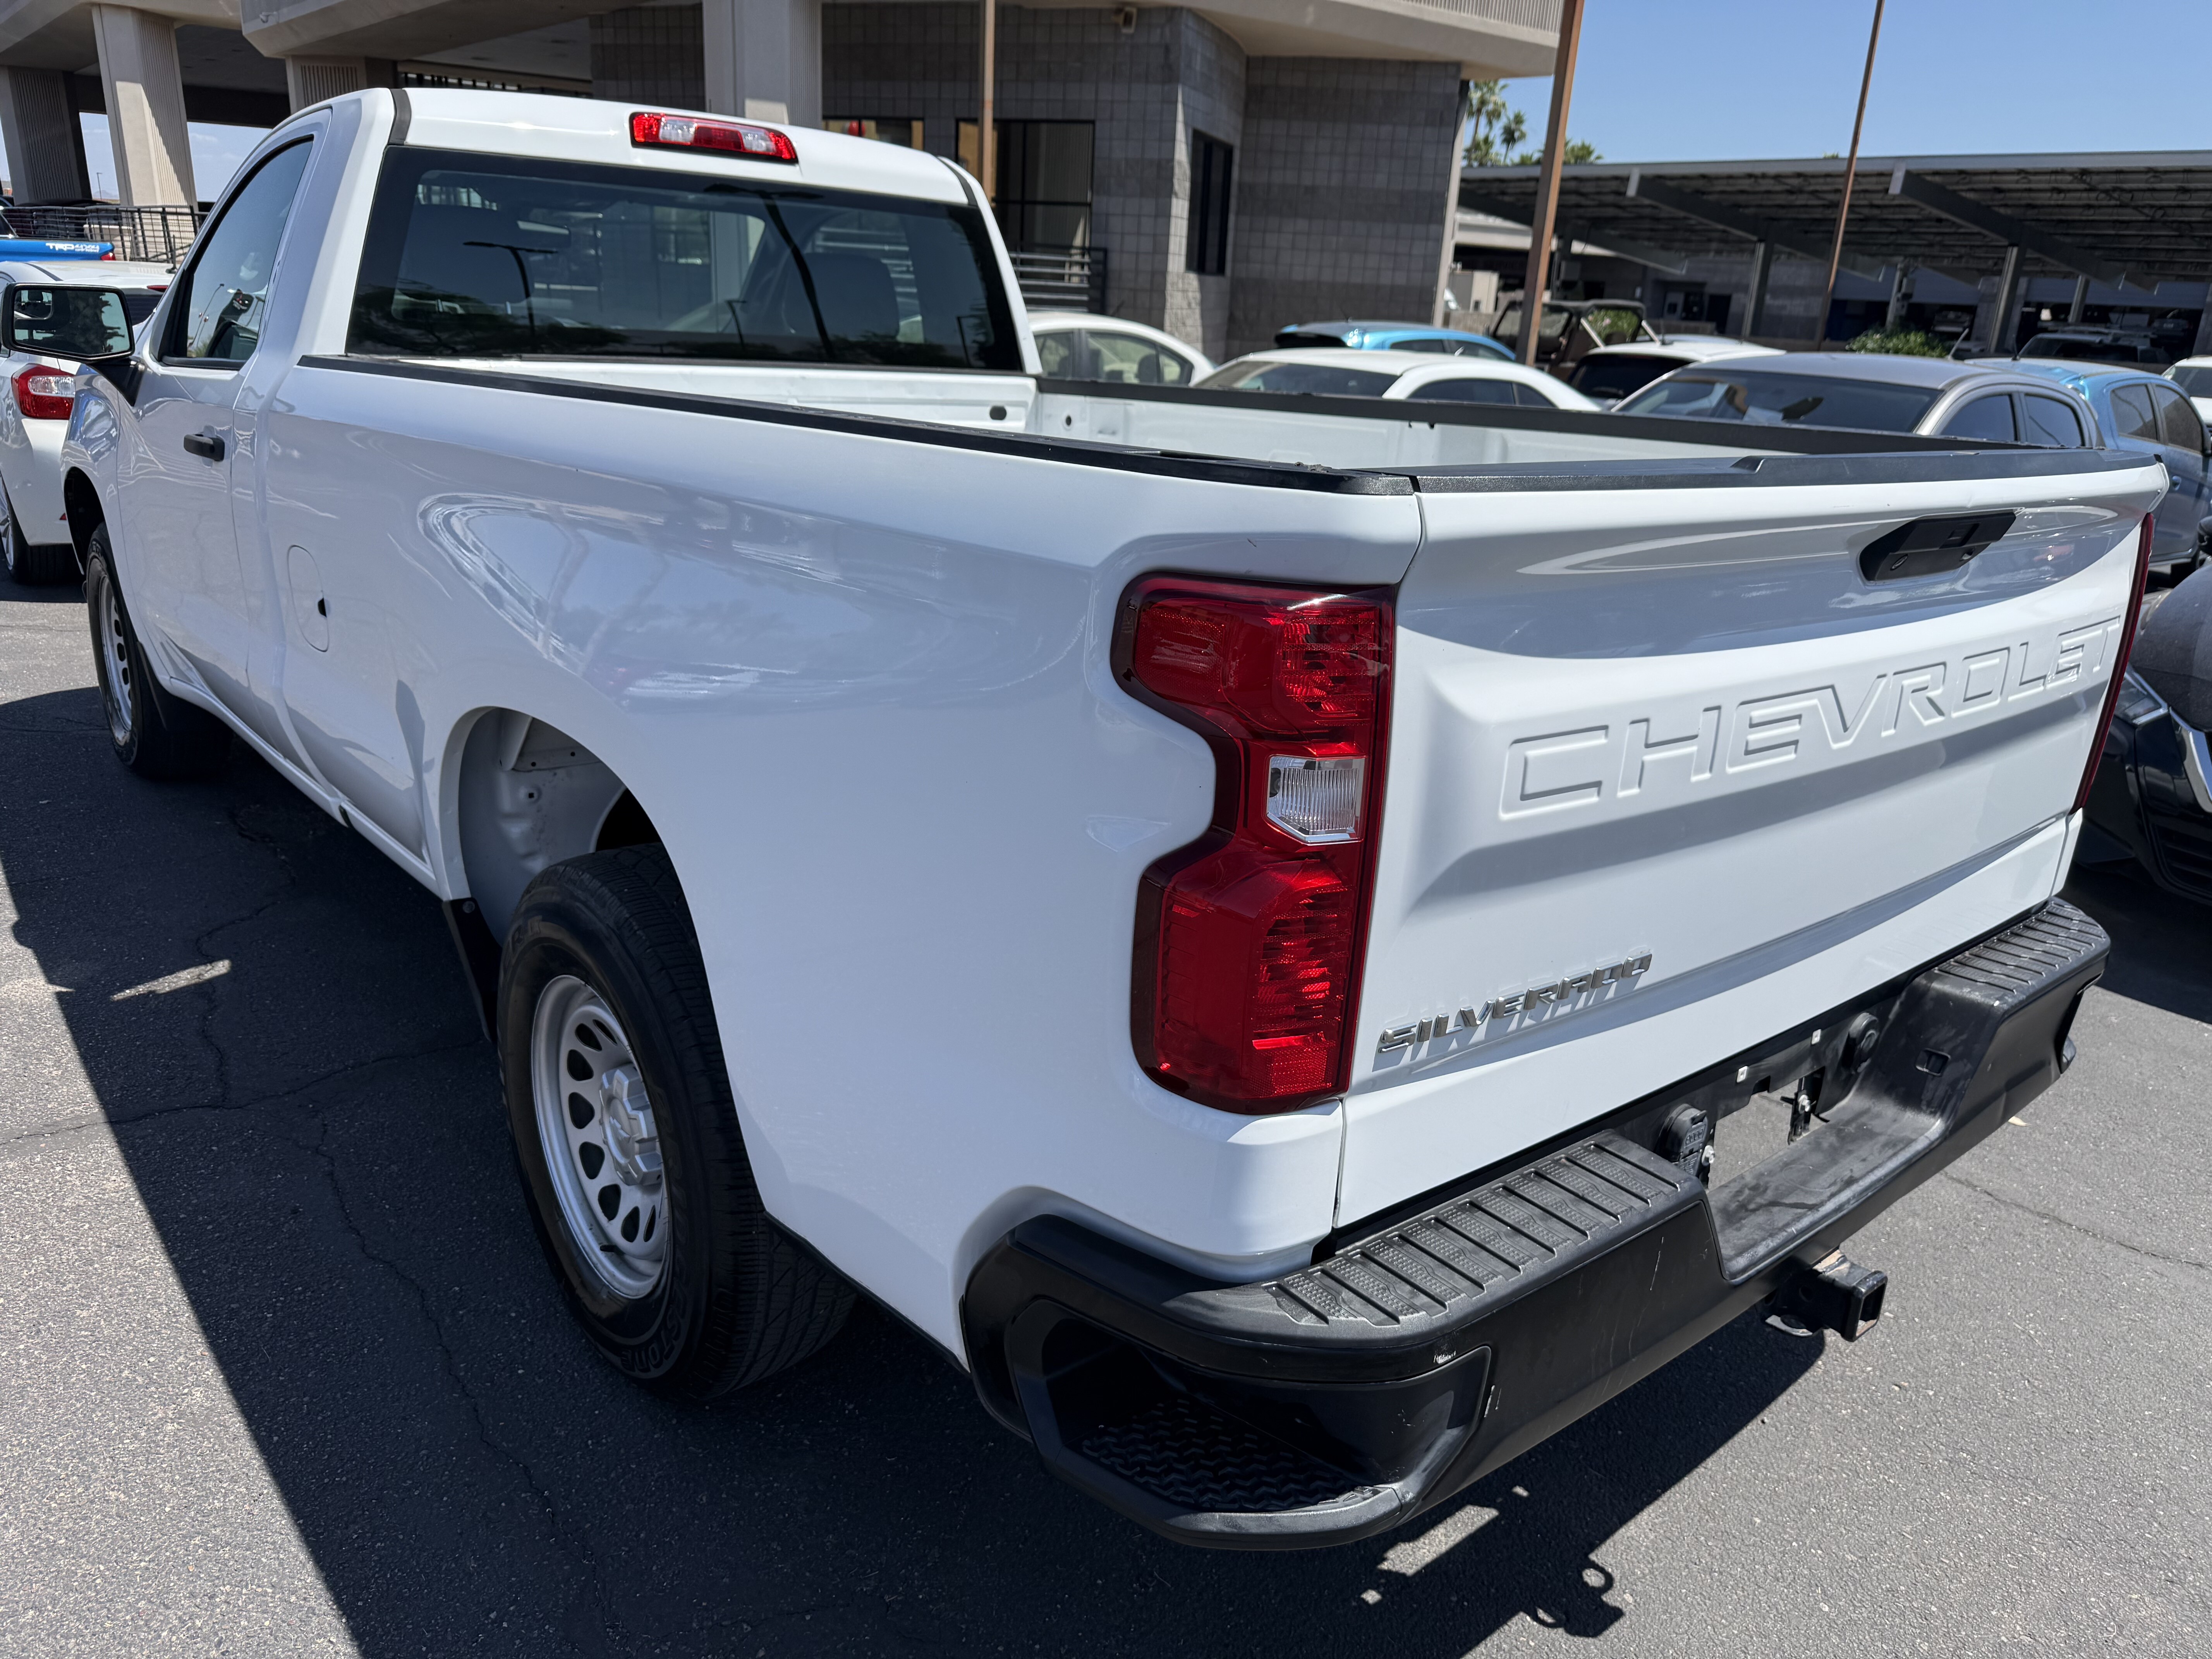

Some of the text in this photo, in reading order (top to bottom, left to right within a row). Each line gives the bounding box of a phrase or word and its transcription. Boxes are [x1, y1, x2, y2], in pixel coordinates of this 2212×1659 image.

[46, 243, 74, 251] TRD
[1499, 615, 2121, 821] CHEVROLET
[1377, 952, 1652, 1053] SILVERADO
